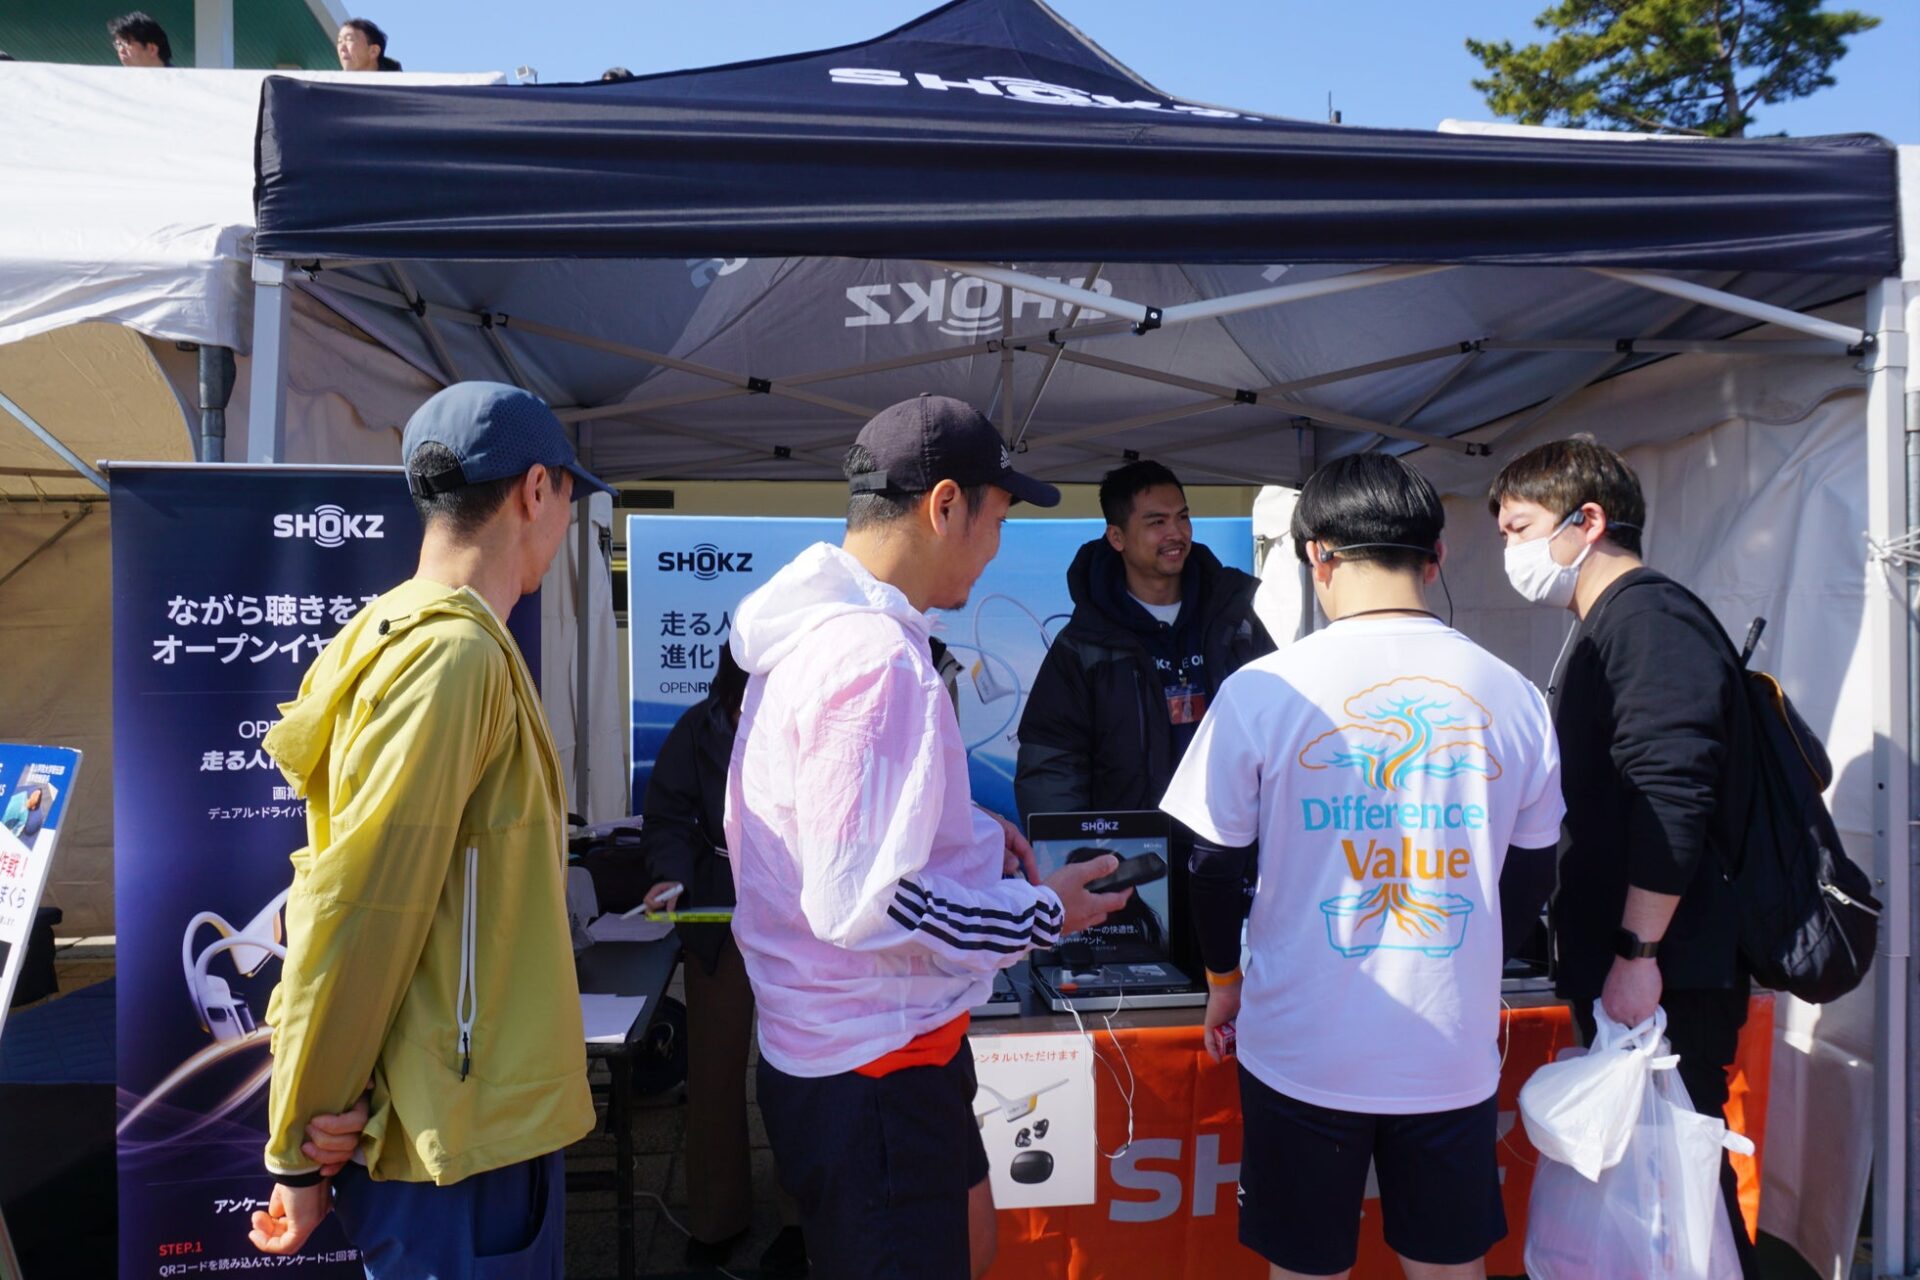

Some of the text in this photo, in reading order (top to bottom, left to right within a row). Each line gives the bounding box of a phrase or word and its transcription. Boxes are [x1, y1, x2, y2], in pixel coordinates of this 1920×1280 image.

[273, 508, 385, 543] SHOKZ
[658, 547, 753, 577] SHOKZ
[167, 594, 379, 626] ながら聴きを
[661, 644, 724, 669] 進化
[208, 806, 306, 820] デュアル・ドライバ
[1081, 820, 1119, 832] SHOKZ
[1301, 795, 1485, 831] Difference
[1341, 837, 1470, 881] Value
[159, 1242, 201, 1256] STEP.1
[159, 1249, 363, 1277] QRコードを読み込んで、アンケートに回答
